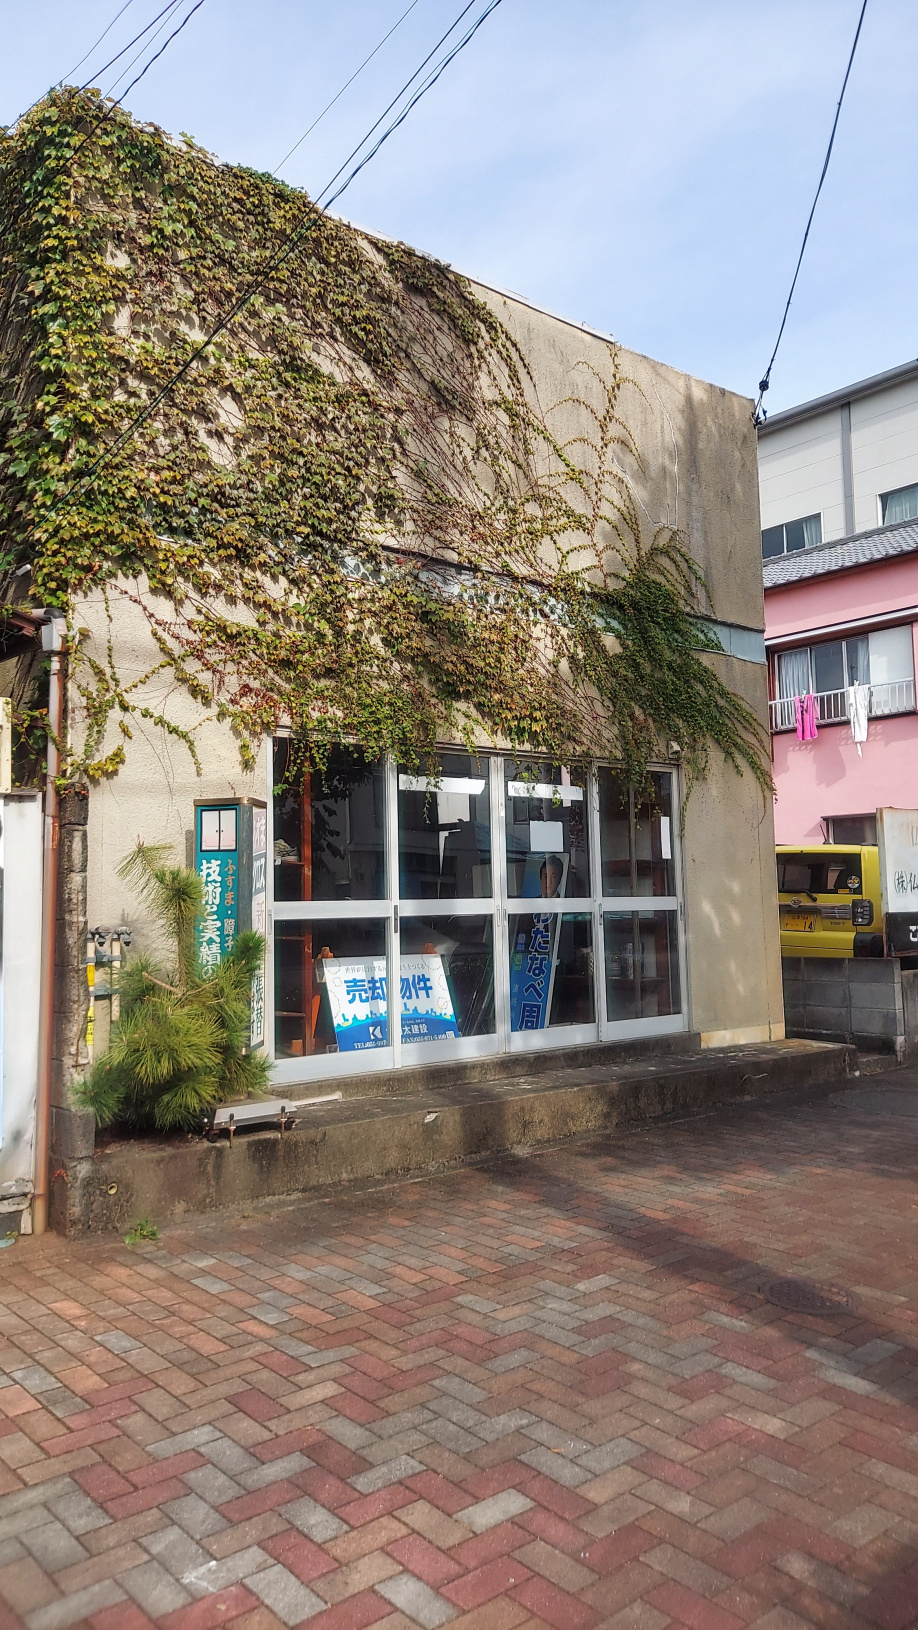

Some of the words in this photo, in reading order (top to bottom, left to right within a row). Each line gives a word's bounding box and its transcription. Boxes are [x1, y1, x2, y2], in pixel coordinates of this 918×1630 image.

[223, 858, 237, 952] ふすま・障子
[400, 1023, 429, 1035] 太建設
